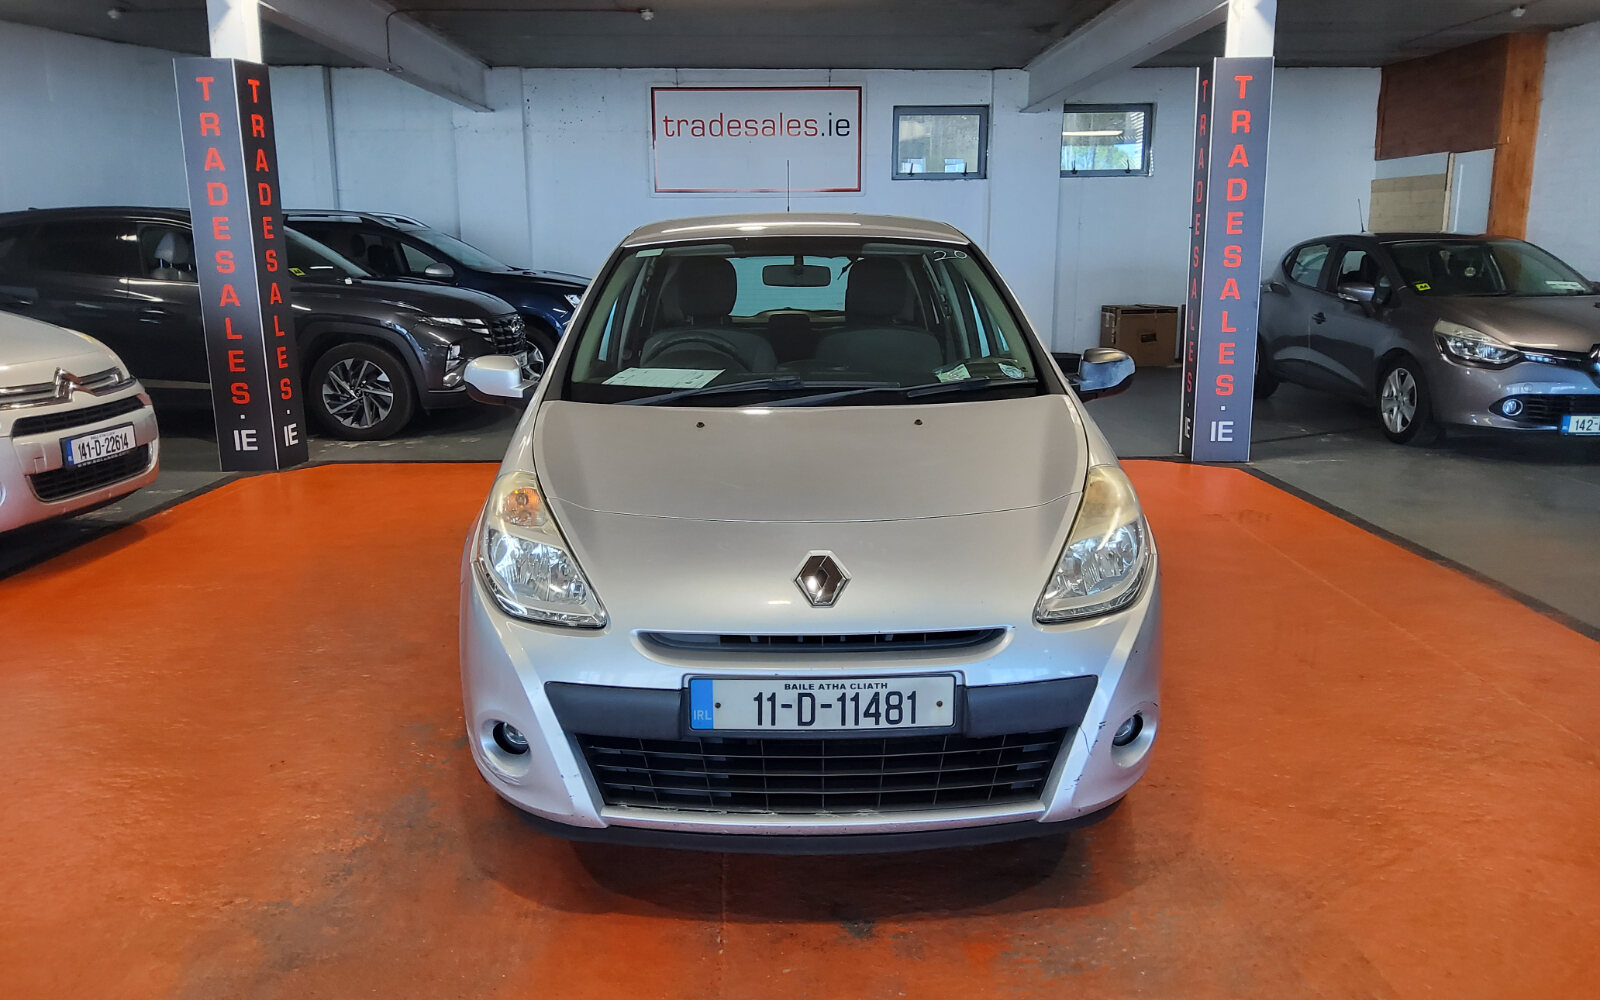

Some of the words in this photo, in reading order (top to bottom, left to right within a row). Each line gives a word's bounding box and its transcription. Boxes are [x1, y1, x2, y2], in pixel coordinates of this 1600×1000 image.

[662, 112, 851, 137] tradesales.ie
[195, 76, 259, 451] TRADESALES.IE
[248, 78, 299, 447] TRADESALES.IE
[933, 250, 968, 262] 20
[1209, 75, 1253, 442] TRADESALES.IE
[1575, 418, 1600, 431] 142-
[77, 432, 129, 461] 141-D-22614
[783, 682, 816, 691] BAILE
[817, 682, 847, 691] ATHA
[849, 682, 888, 690] CLIATH
[693, 709, 712, 721] IRL
[753, 690, 918, 727] 11-D-11481
